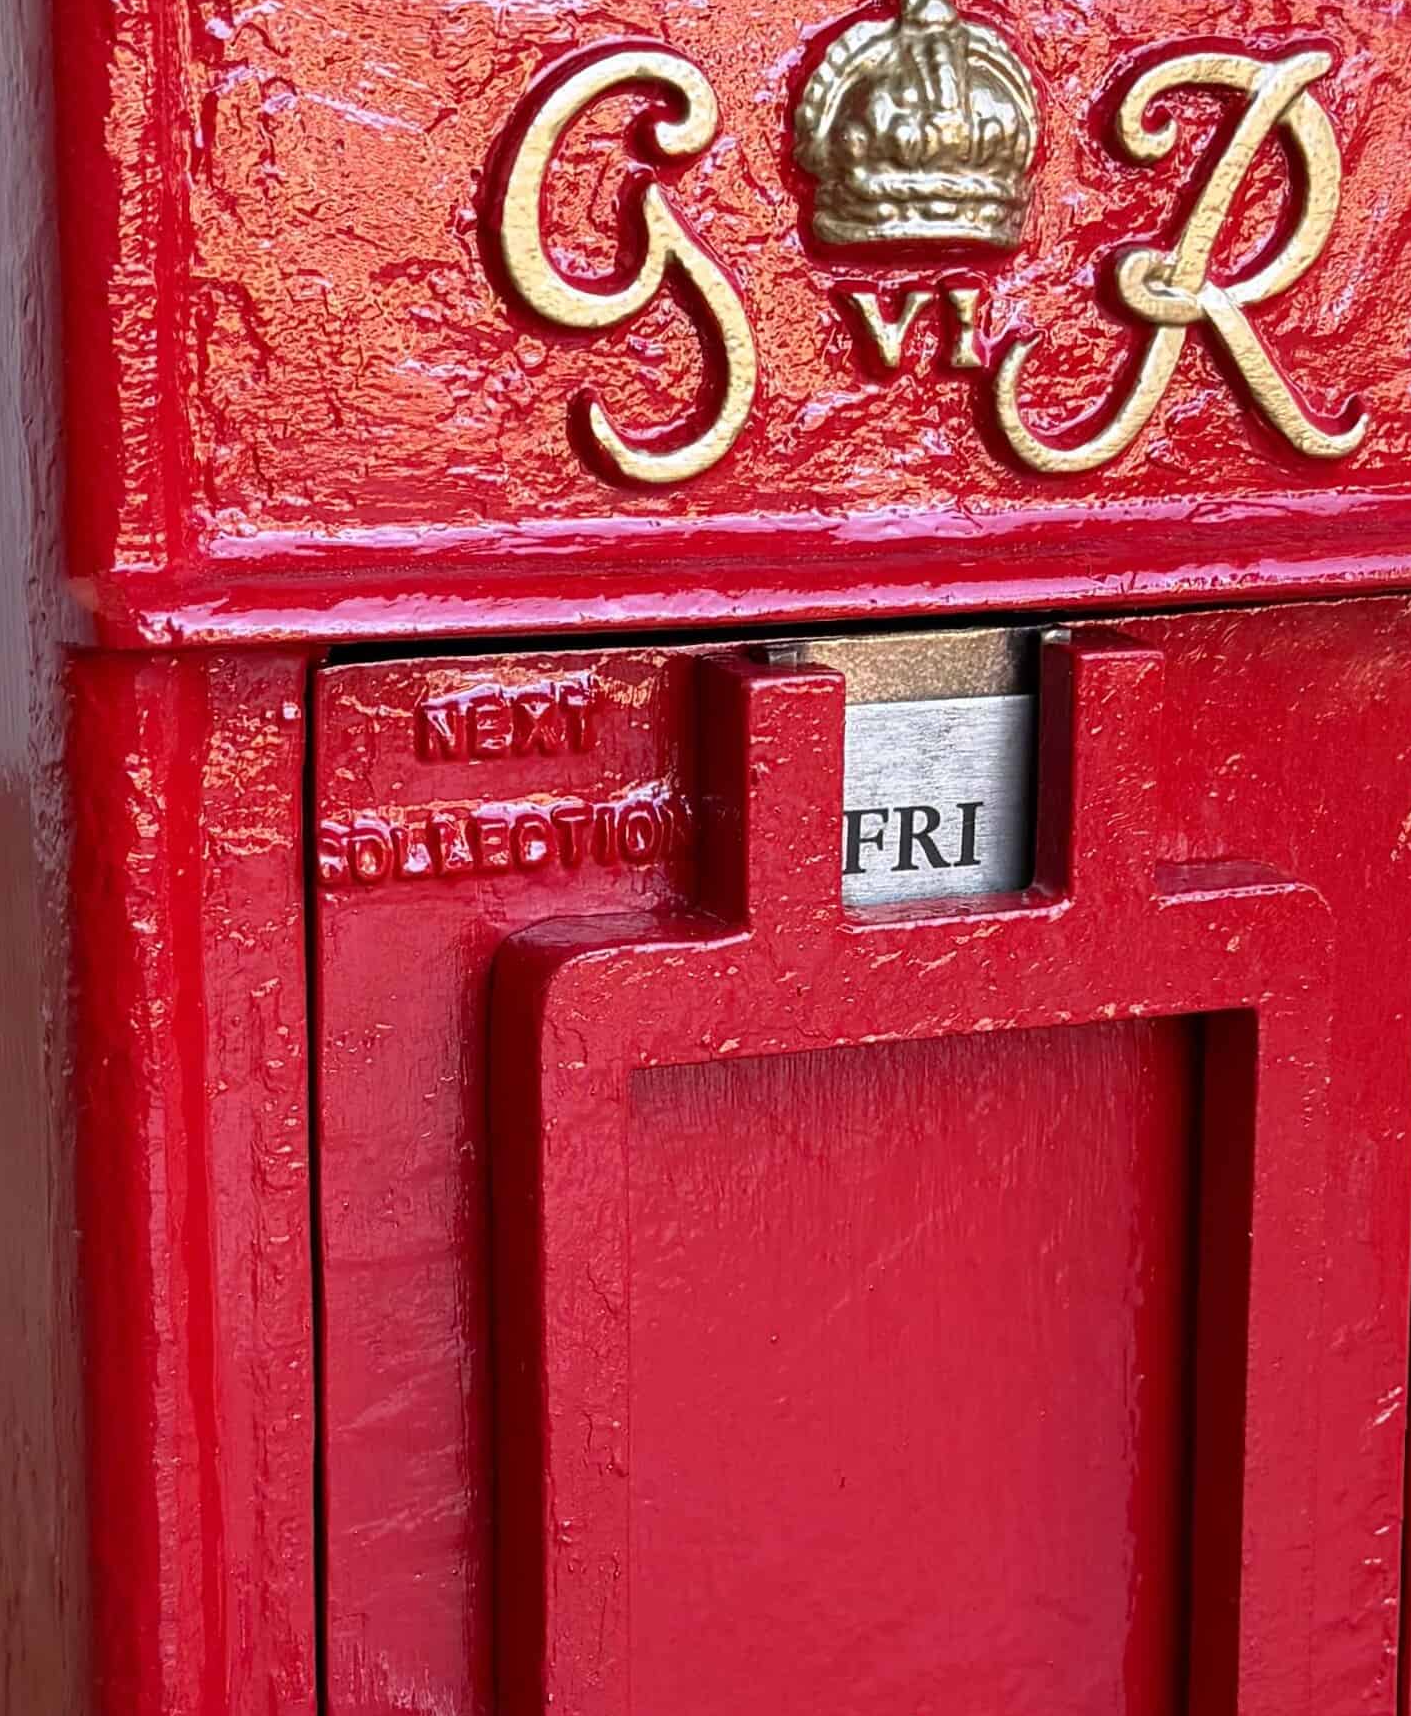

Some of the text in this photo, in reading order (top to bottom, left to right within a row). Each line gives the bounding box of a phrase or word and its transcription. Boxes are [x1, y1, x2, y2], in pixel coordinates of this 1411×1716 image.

[501, 48, 1369, 484] G R
[849, 288, 991, 369] VI
[417, 676, 595, 758] NEXT
[318, 793, 675, 884] COLLECTIO
[842, 800, 984, 875] FRI
